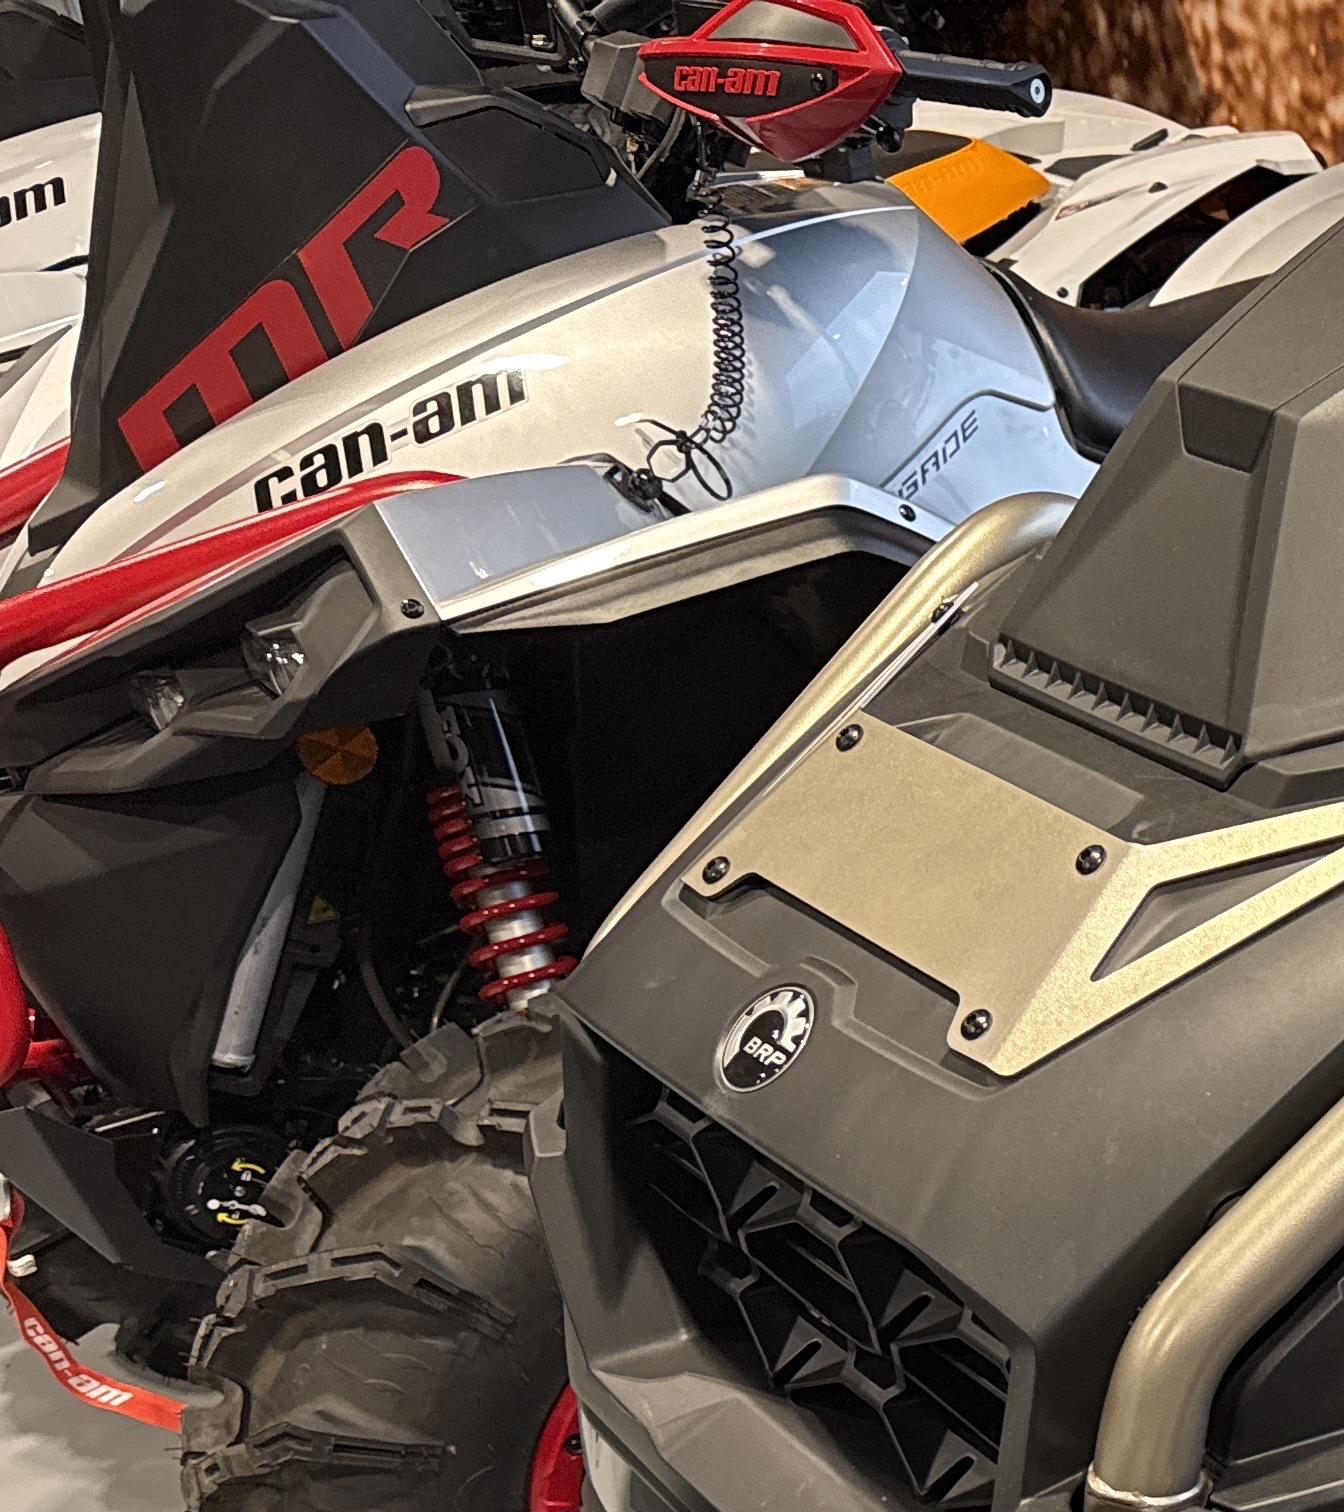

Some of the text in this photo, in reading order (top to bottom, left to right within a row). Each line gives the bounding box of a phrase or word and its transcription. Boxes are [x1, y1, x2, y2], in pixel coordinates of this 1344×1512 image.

[674, 66, 781, 96] can-am
[253, 368, 526, 513] can-am
[743, 1036, 787, 1066] BRP
[24, 1317, 133, 1406] can-am
